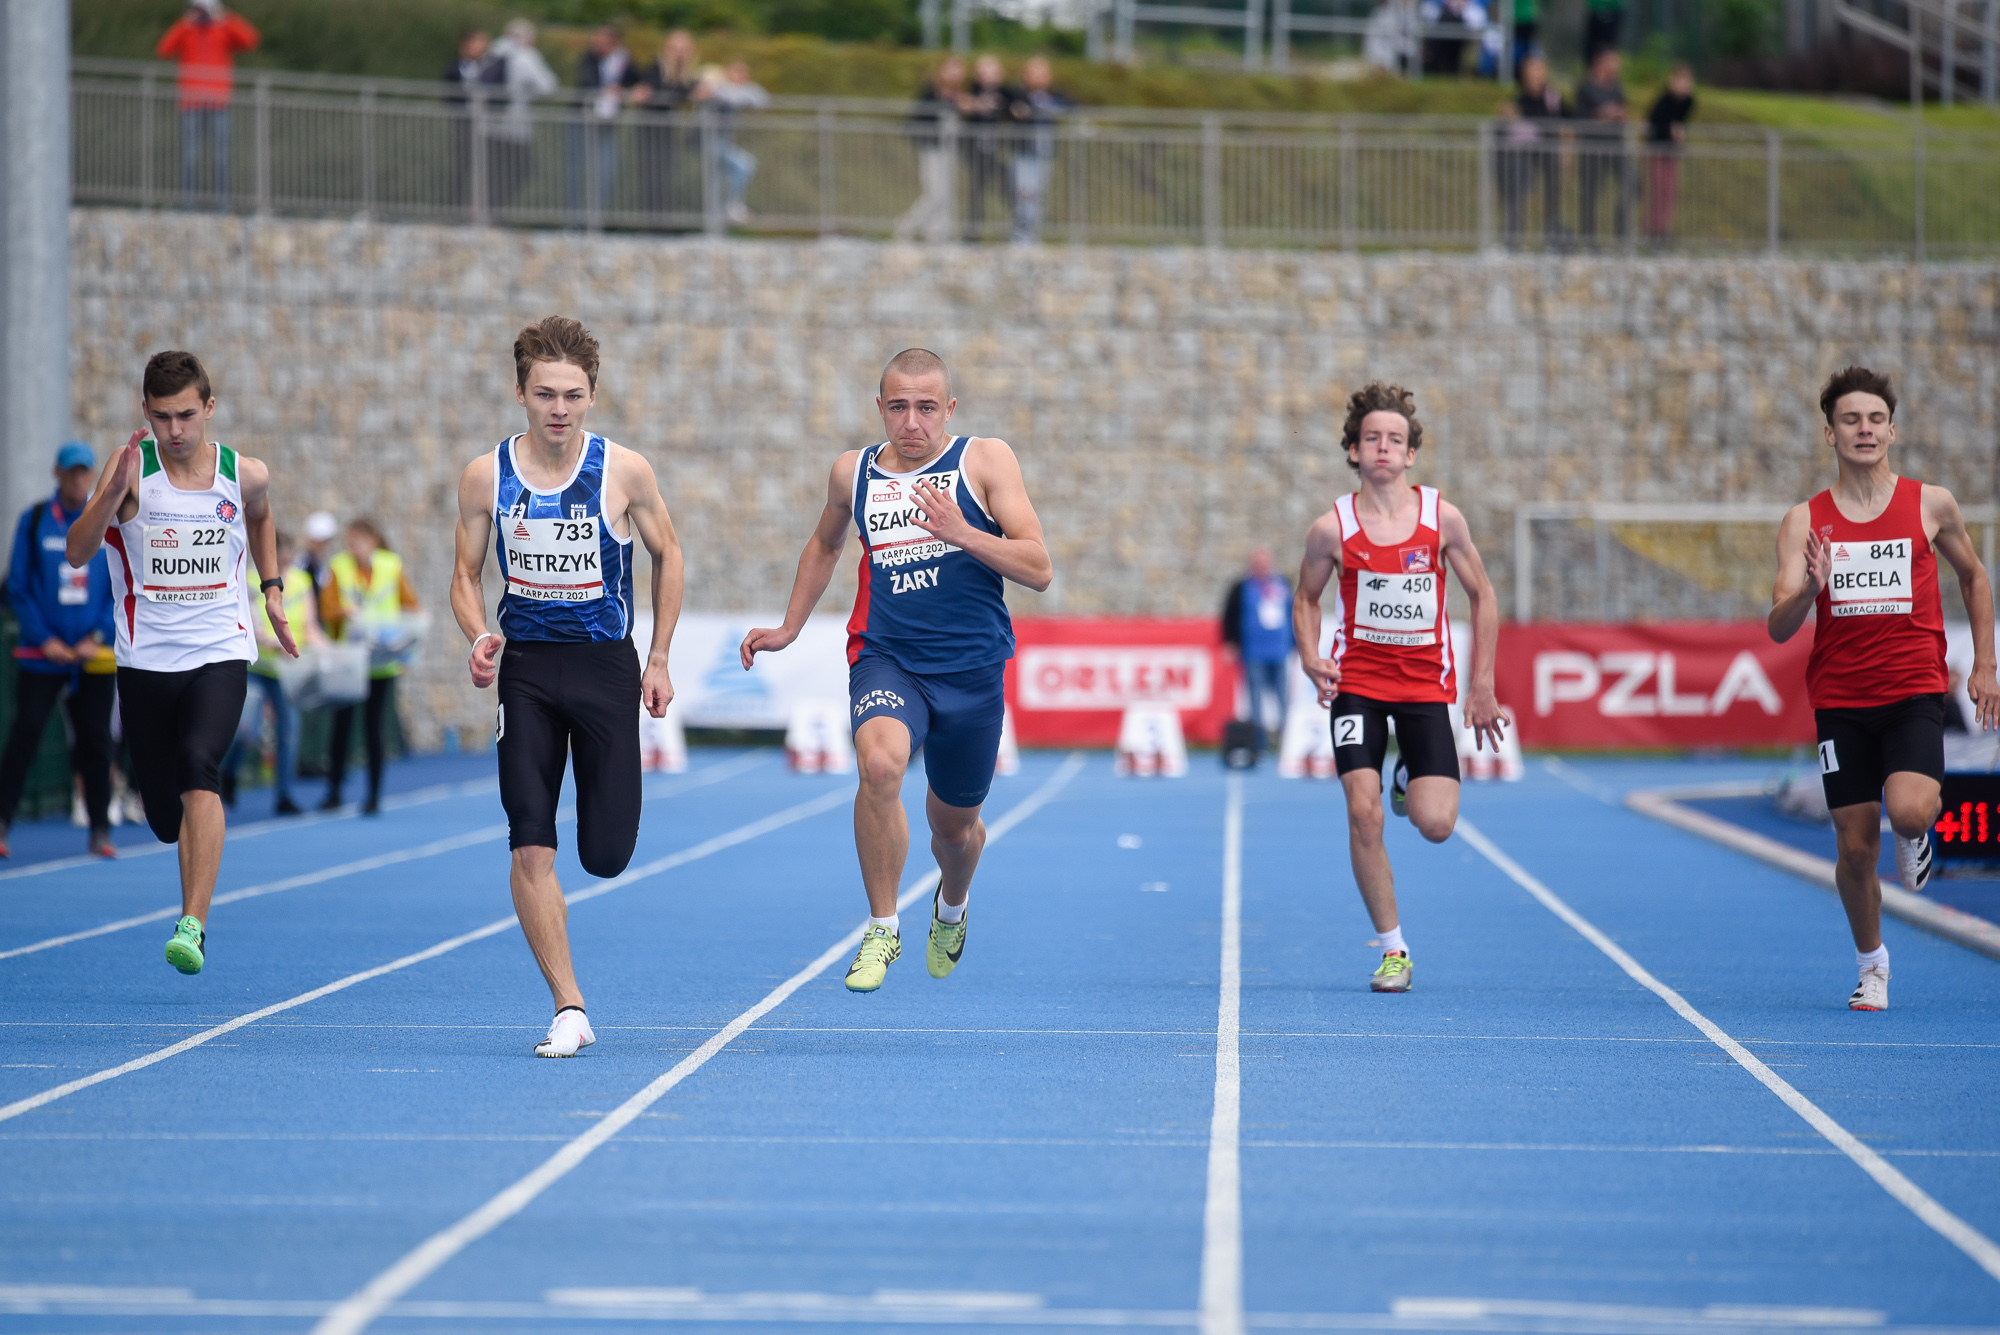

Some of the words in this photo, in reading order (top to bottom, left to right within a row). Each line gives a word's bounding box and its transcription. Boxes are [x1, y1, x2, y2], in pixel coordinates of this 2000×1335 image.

[873, 492, 901, 502] ORLEN
[192, 528, 226, 546] 222
[553, 522, 593, 542] 733
[151, 540, 178, 548] ORLEN
[881, 546, 923, 560] KARPACZ
[925, 542, 948, 554] 2021
[1870, 542, 1906, 560] 841
[152, 556, 221, 575] RUDNIK
[508, 548, 598, 573] PIETRZYK
[889, 567, 940, 595] ŻARY
[1402, 577, 1432, 593] 450
[1833, 571, 1902, 590] BECELA
[155, 592, 197, 602] KARPACZ
[199, 591, 218, 601] 2021
[520, 586, 564, 600] KARPACZ
[566, 590, 589, 600] 2021
[1369, 602, 1424, 620] ROSSA
[1838, 605, 1877, 615] KARPACZ
[1879, 604, 1900, 613] 2021
[1365, 632, 1404, 645] KARPACZ
[1406, 636, 1424, 645] 2021
[1034, 662, 1195, 696] ORLEN
[1533, 650, 1783, 718] PZLA
[1340, 719, 1356, 743] 2
[1820, 744, 1830, 771] 1
[1935, 801, 2000, 843] +11
